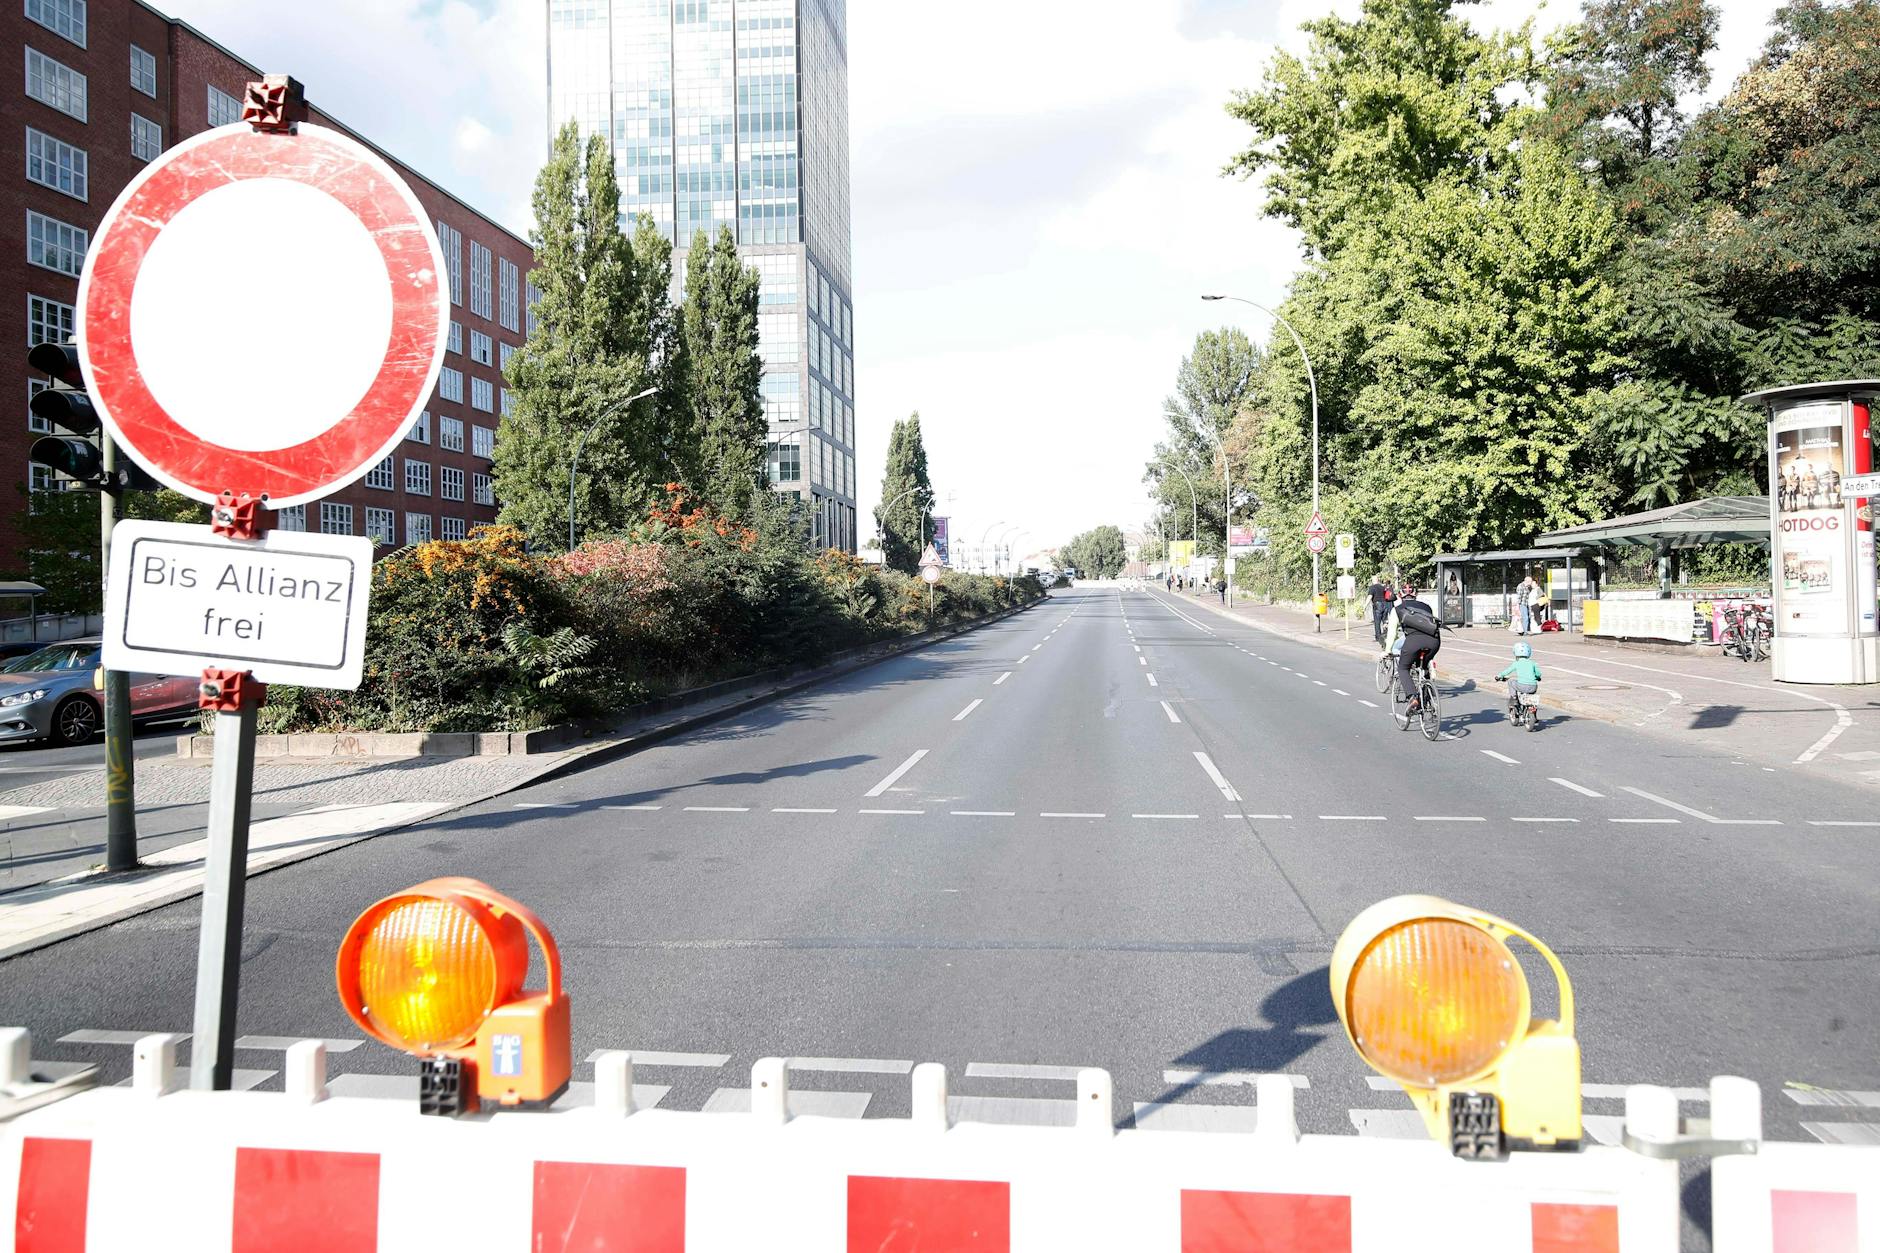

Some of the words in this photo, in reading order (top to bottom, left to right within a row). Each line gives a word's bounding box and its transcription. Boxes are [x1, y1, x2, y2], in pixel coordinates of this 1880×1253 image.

[1844, 482, 1855, 491] An
[1856, 480, 1869, 491] den
[1779, 516, 1839, 532] HOTDOG
[1312, 539, 1322, 548] 30
[143, 556, 197, 588] Bis
[216, 563, 343, 603] Allianz
[204, 608, 264, 640] frei
